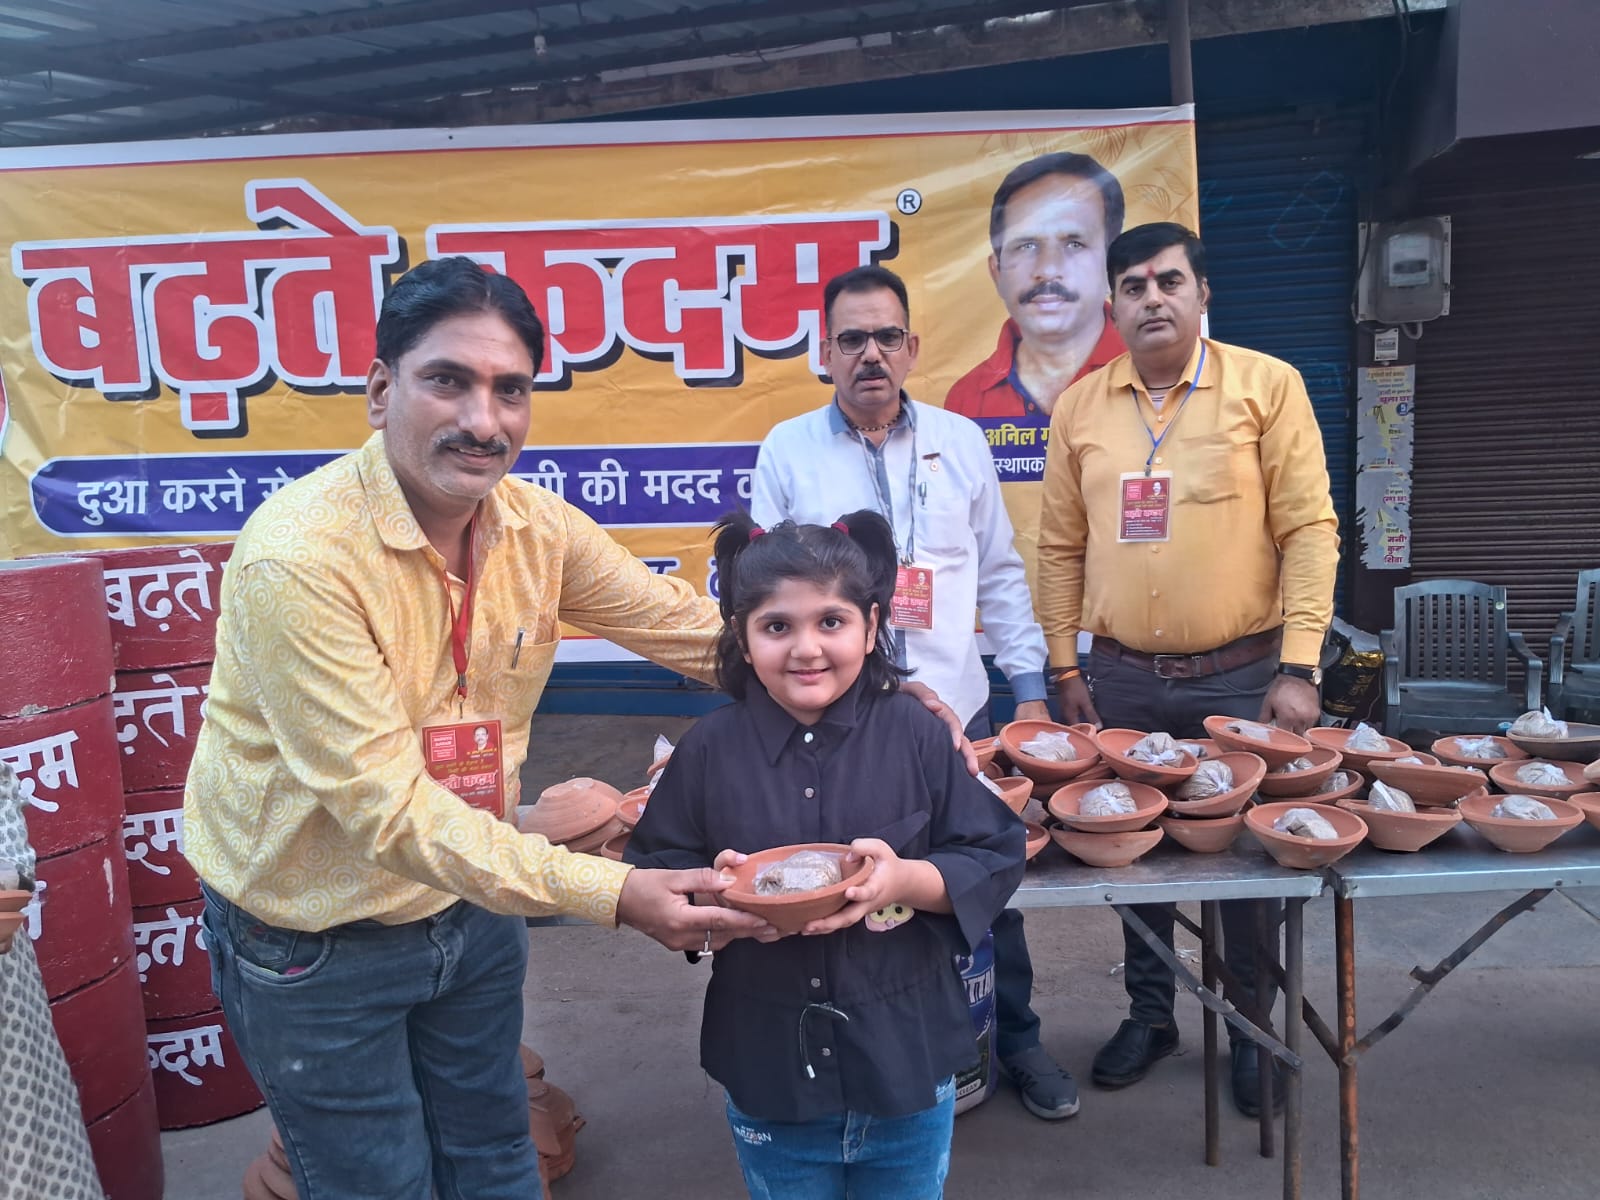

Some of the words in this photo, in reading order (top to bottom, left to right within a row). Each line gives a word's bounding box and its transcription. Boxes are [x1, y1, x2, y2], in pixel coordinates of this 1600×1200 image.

[12, 178, 402, 432] बढ़ते
[985, 423, 1037, 446] अनिल
[992, 457, 1045, 473] स्थापक
[77, 480, 149, 526] दुआ
[160, 467, 246, 513] करने
[578, 458, 629, 505] की
[640, 468, 722, 504] मदद
[103, 548, 214, 632] बढ़ते
[112, 673, 200, 755] ढ़ते
[0, 730, 79, 812] दम
[124, 808, 184, 875] दम
[133, 907, 194, 983] ढ़ते
